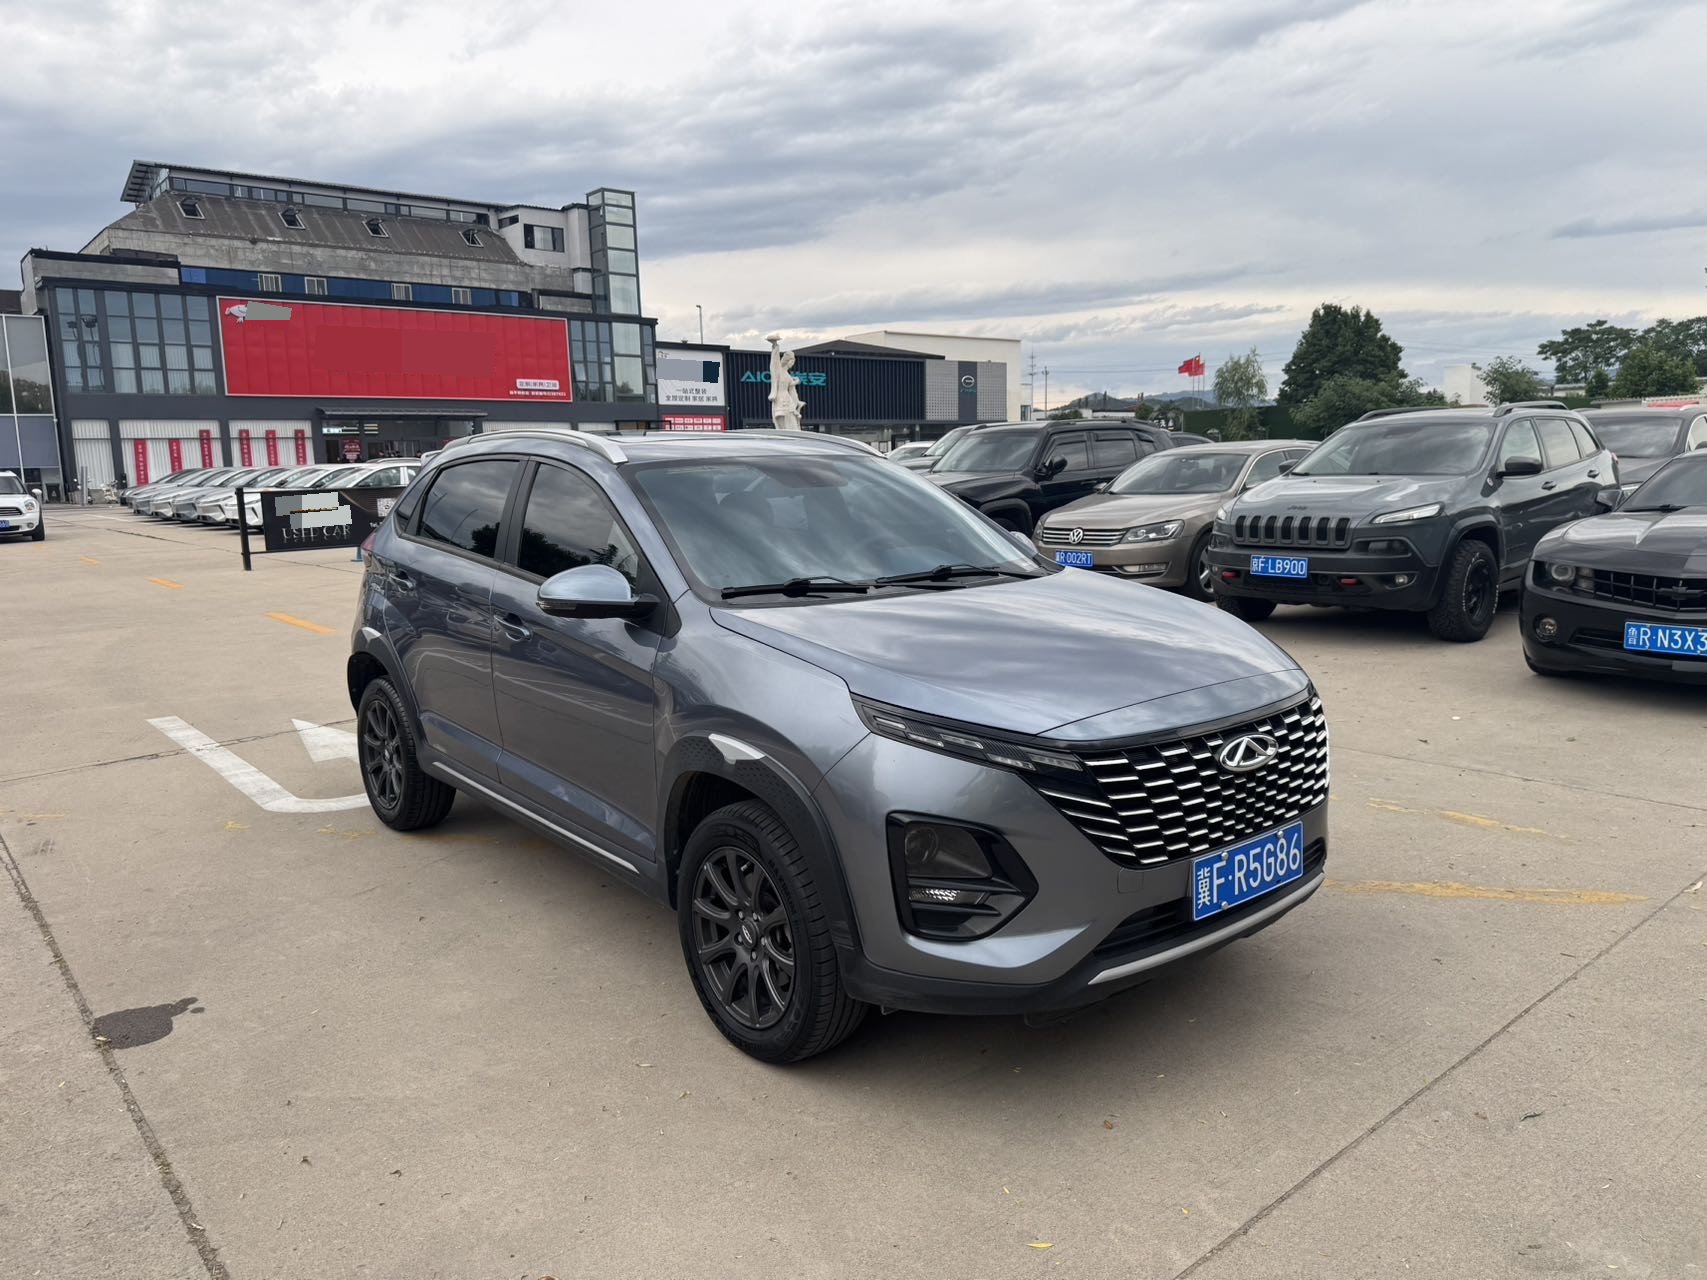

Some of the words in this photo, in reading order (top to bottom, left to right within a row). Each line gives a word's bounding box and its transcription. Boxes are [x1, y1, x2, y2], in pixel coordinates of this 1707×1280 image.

[740, 371, 771, 382] AIO
[323, 525, 351, 537] CAR
[1197, 833, 1300, 909] 冀F·R5G86
